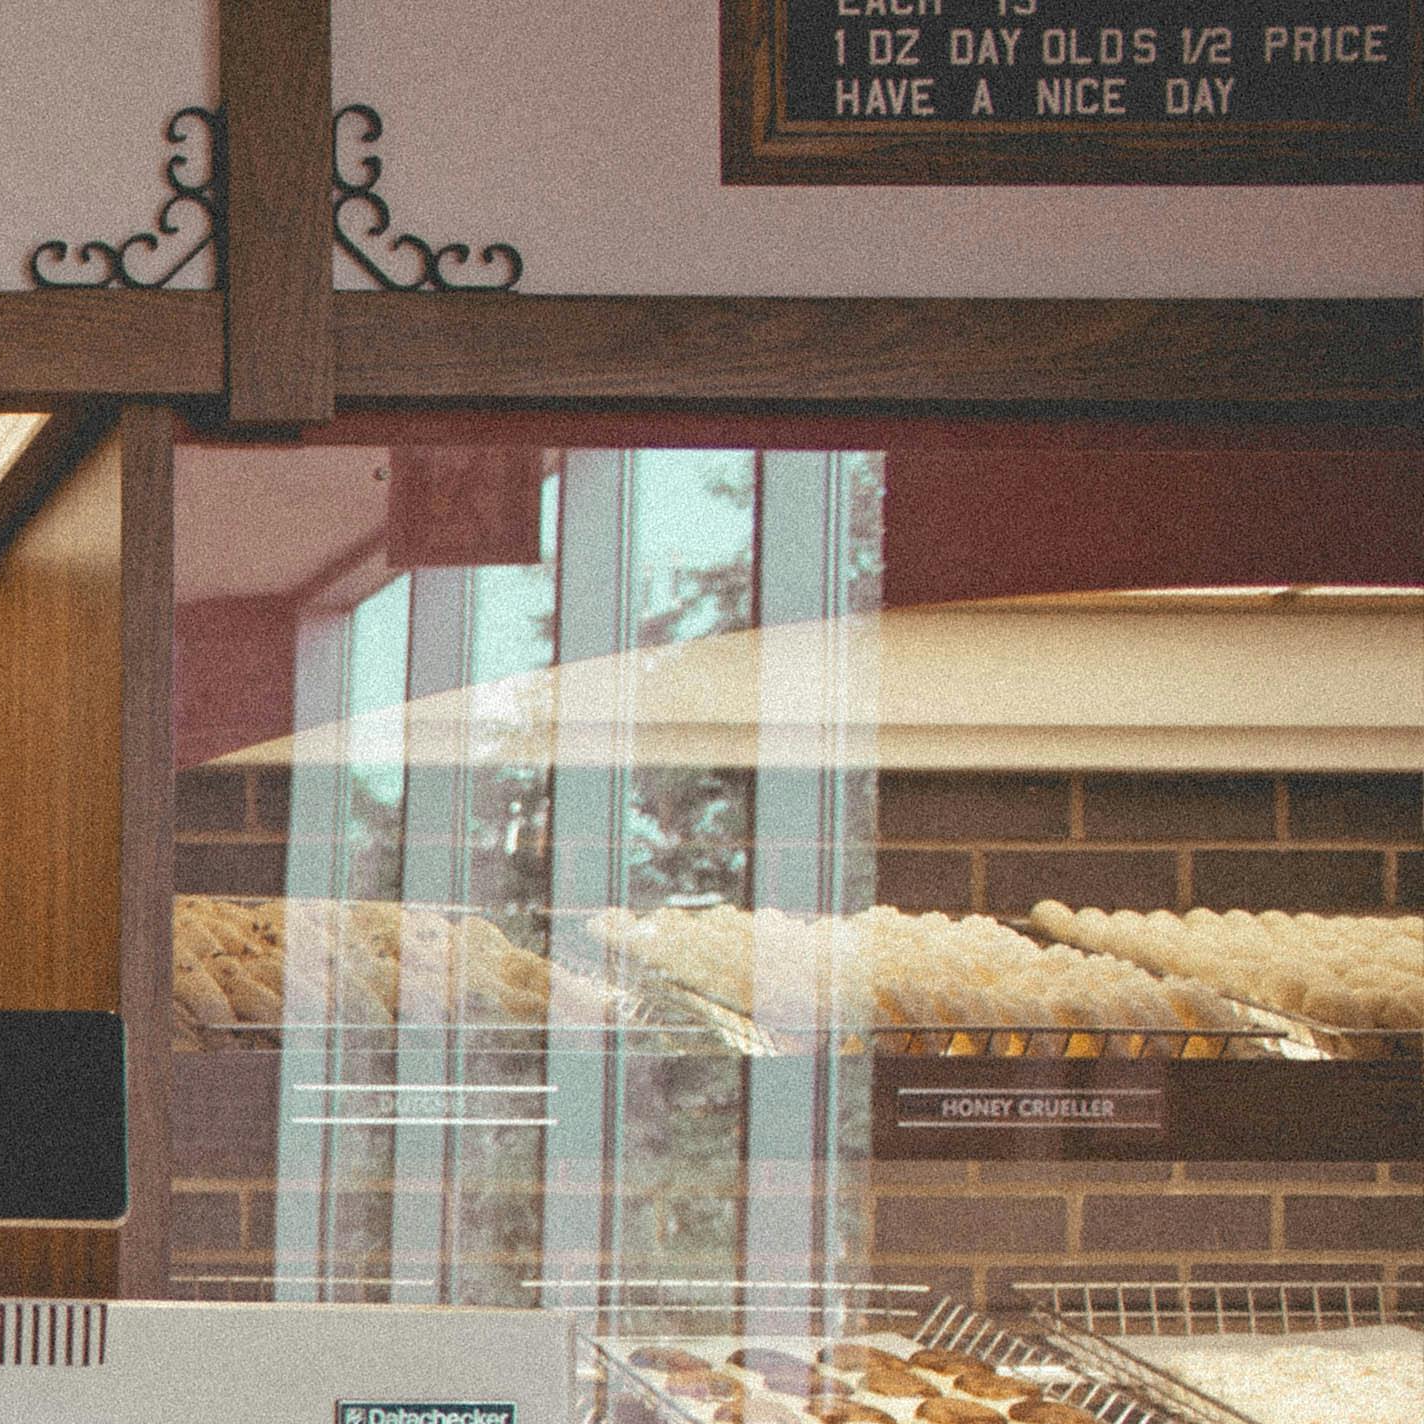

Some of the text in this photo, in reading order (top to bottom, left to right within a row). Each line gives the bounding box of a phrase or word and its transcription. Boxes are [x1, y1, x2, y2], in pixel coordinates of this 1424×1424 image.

[834, 28, 845, 65] 1
[950, 28, 1022, 65] DAY
[1042, 27, 1157, 65] OLDS
[1181, 26, 1232, 64] 1/2
[1264, 25, 1388, 63] PRICE
[836, 77, 1234, 115] HAVE A NICE DAY
[942, 1099, 1114, 1117] HONEY CRUELLER
